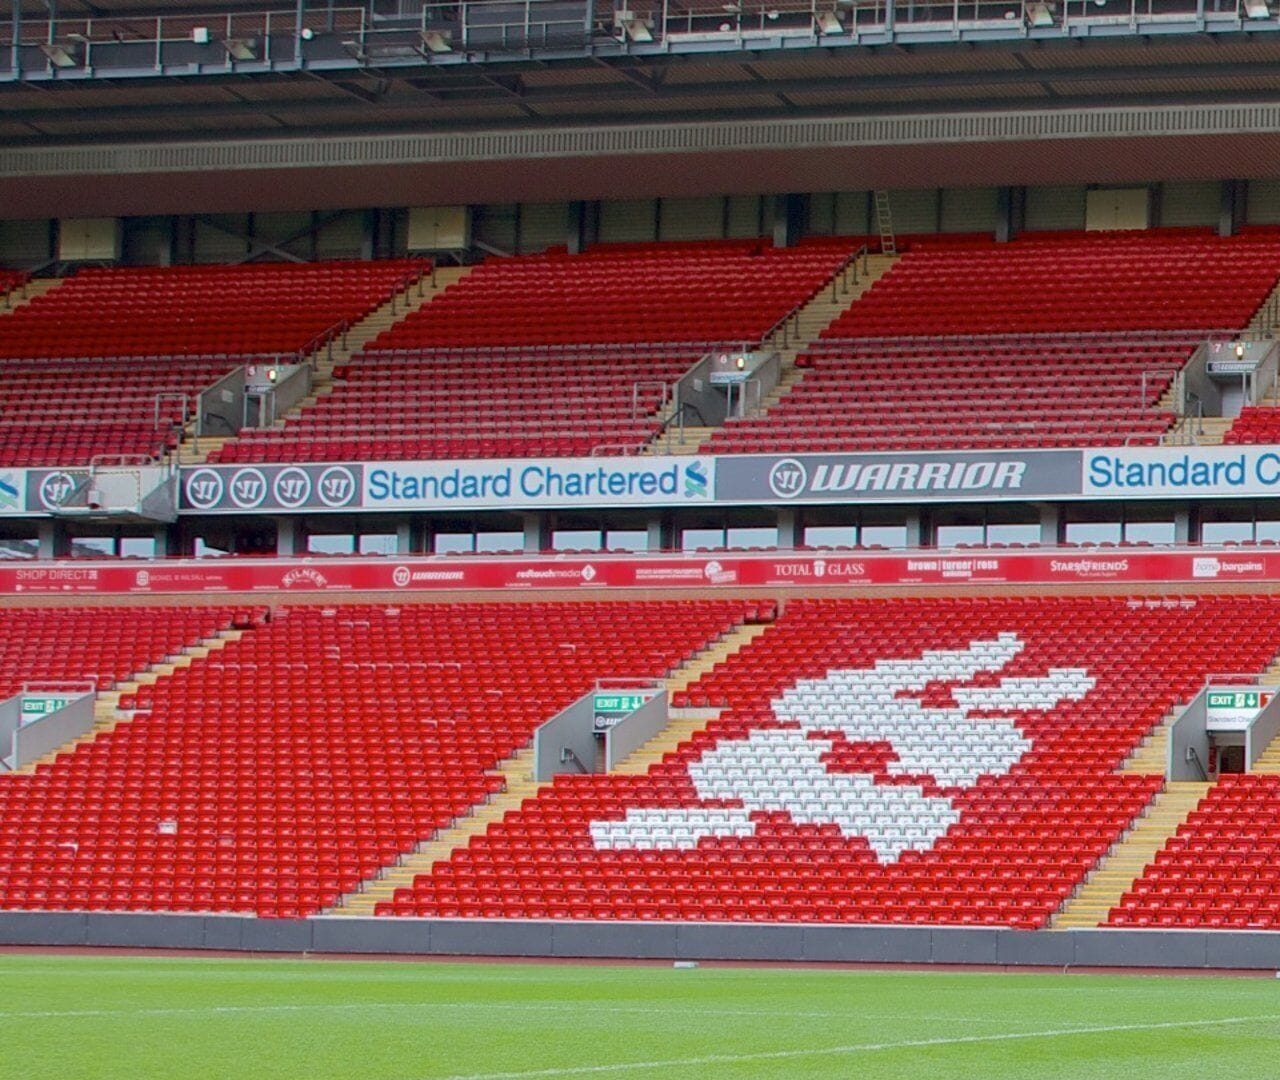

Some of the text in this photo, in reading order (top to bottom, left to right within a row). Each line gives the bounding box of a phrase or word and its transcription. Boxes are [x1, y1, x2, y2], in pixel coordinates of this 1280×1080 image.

[812, 461, 1027, 490] WARRIOR
[1089, 454, 1246, 488] Standard
[368, 463, 679, 500] Standard Chartered
[774, 563, 865, 576] TOTAL GLASS
[1222, 561, 1262, 574] bargains
[16, 569, 88, 580] SHOP DIRECT
[411, 570, 464, 580] WARRIOR
[1210, 695, 1234, 705] EXIT
